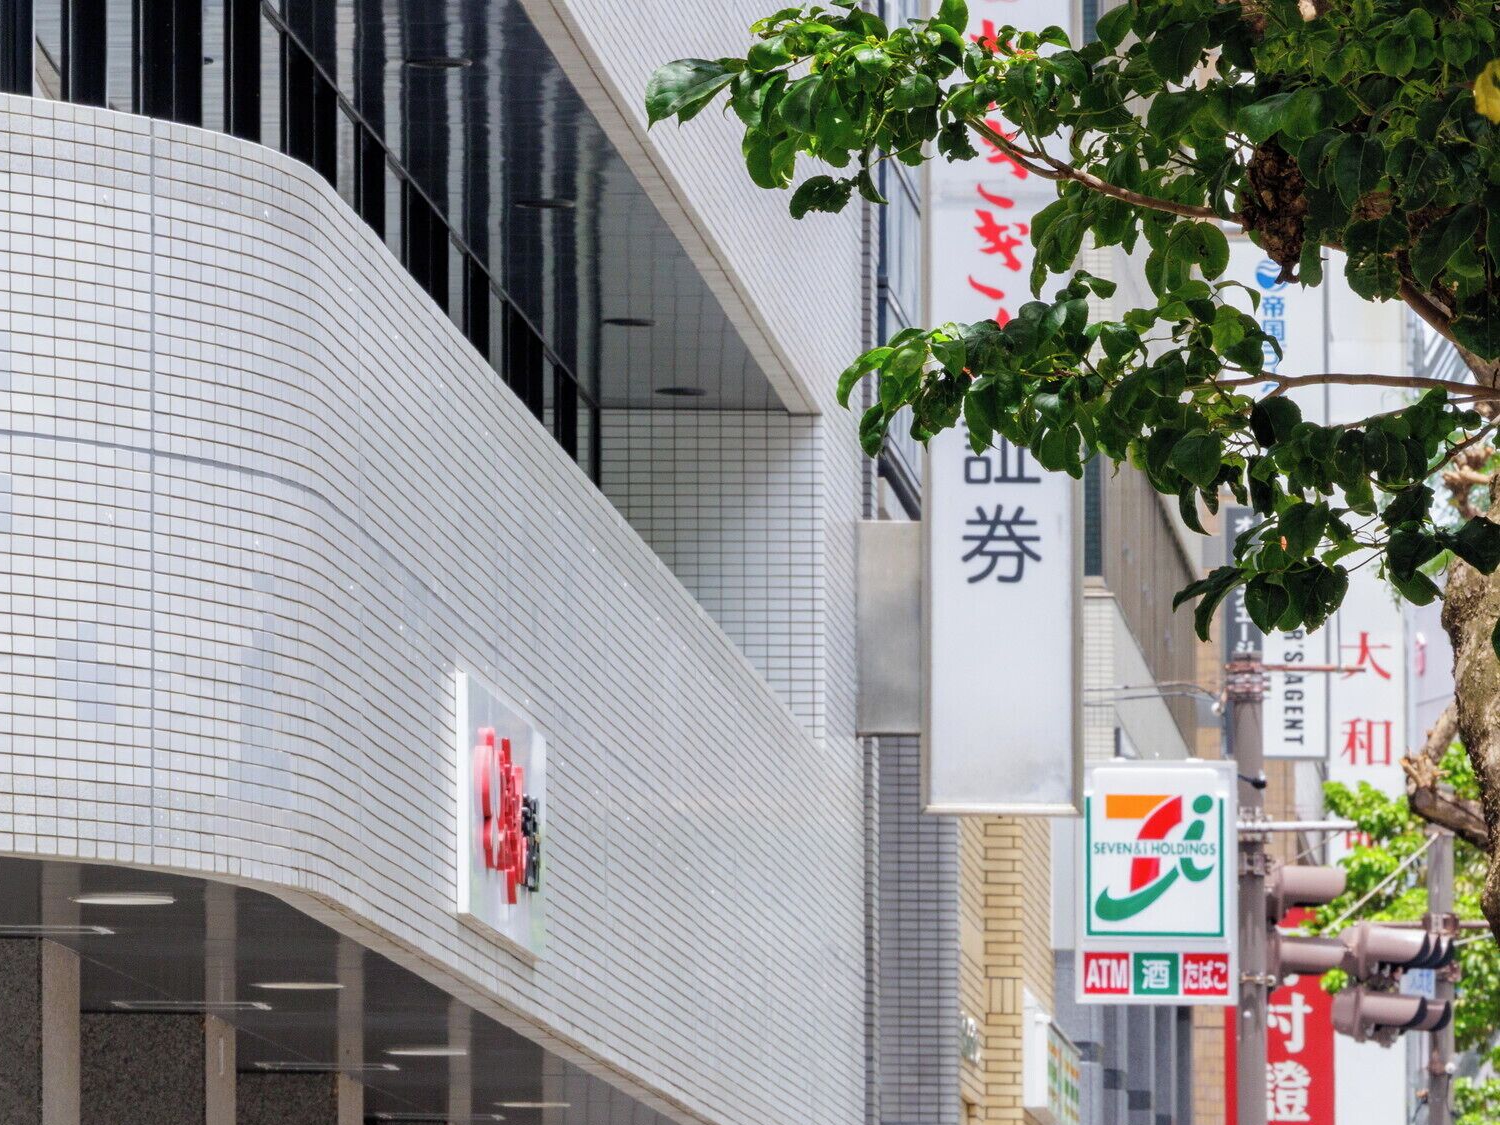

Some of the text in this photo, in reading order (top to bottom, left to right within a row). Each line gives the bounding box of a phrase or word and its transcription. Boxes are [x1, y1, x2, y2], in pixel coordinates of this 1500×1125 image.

[1284, 673, 1304, 746] AGENT
[1152, 842, 1216, 856] HOLDINGS
[1086, 958, 1128, 989] ATM
[1141, 959, 1171, 990] 酒
[1183, 959, 1228, 990] たばこ
